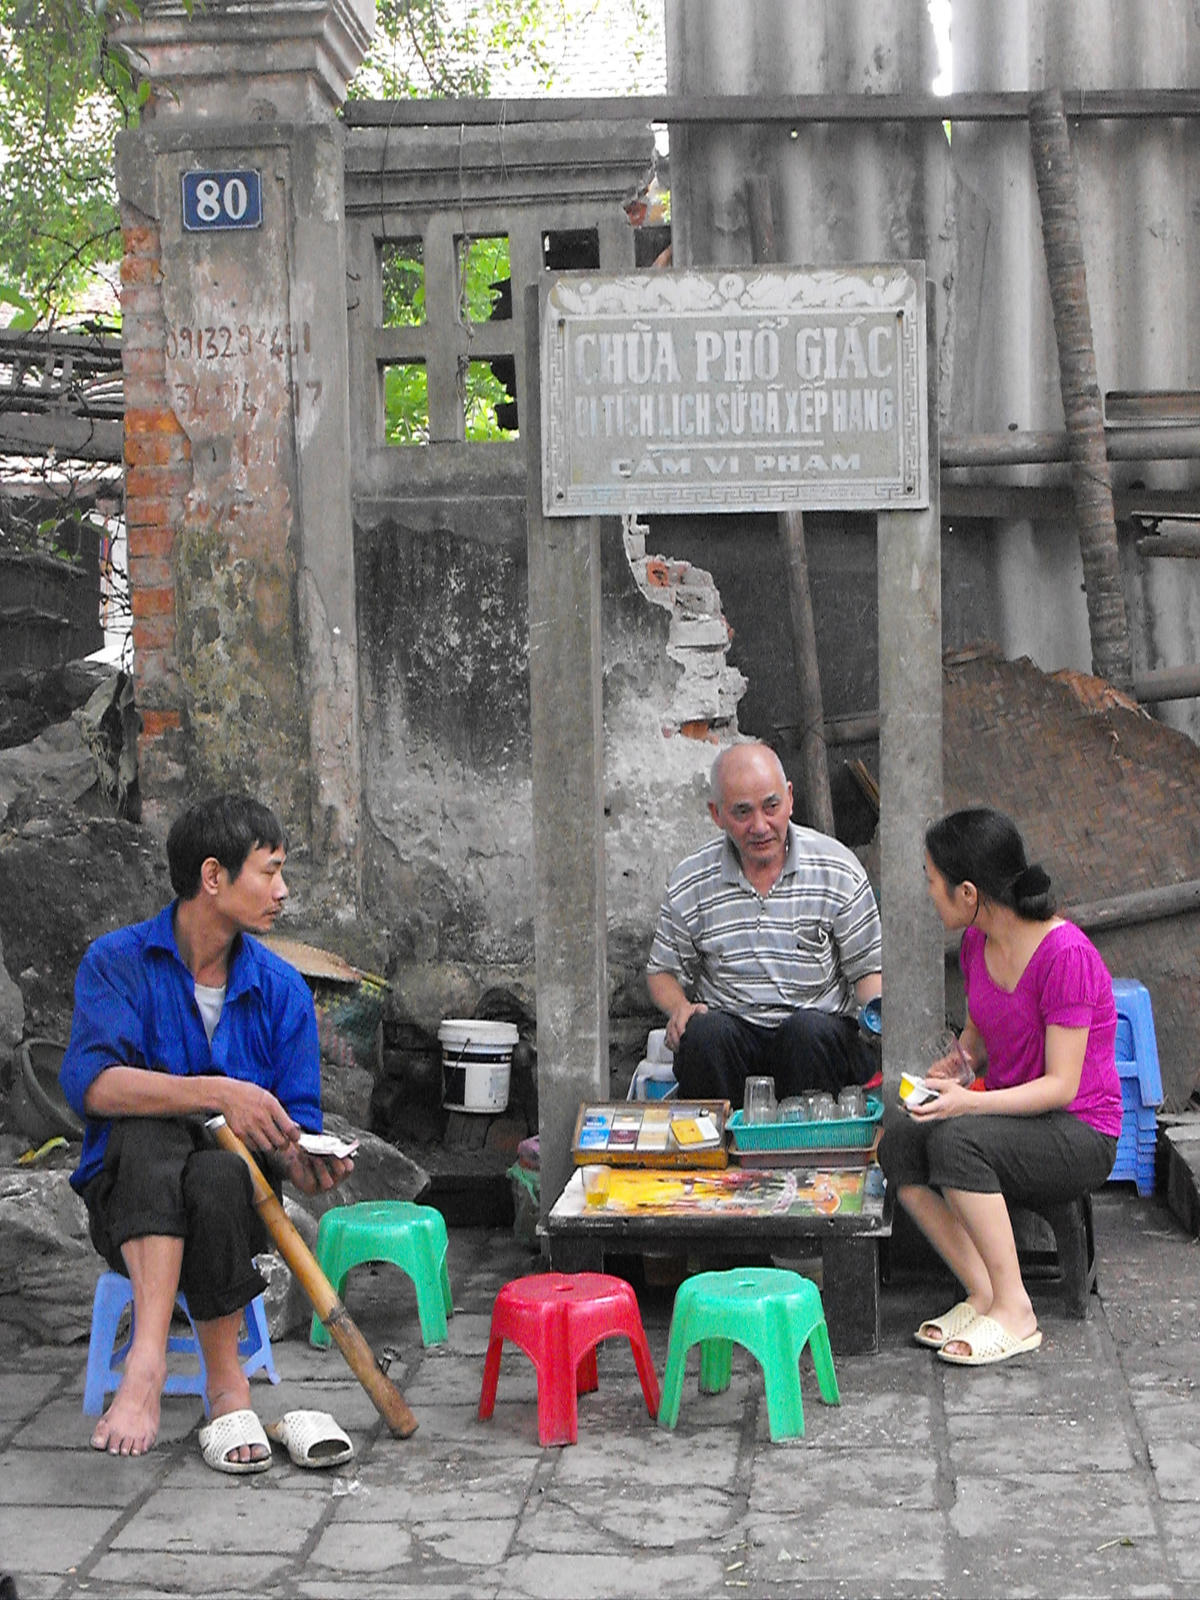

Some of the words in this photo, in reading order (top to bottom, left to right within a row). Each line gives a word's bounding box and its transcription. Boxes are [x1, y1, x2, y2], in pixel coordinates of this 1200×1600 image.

[195, 178, 248, 222] 80
[575, 321, 682, 385] CHÙA
[695, 316, 789, 383] PHỔ
[796, 315, 893, 380] GIÁC
[704, 456, 739, 474] VI
